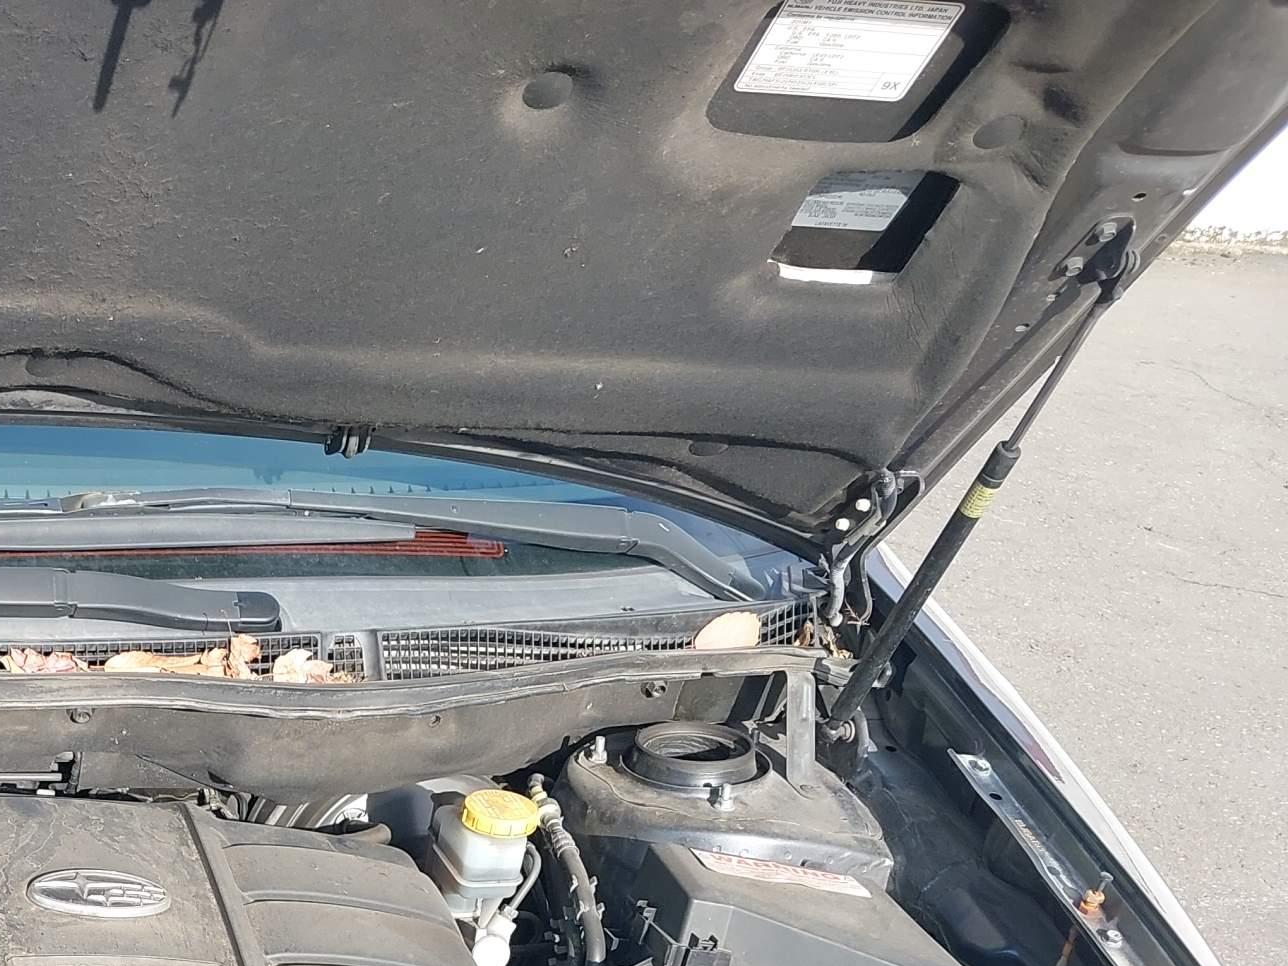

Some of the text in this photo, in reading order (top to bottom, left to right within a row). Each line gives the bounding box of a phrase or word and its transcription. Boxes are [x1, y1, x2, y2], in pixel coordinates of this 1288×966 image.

[868, 2, 909, 11] INDUSTRIES
[908, 12, 953, 20] INFORMATION
[880, 80, 901, 91] 9X
[708, 853, 842, 881] WARNING
